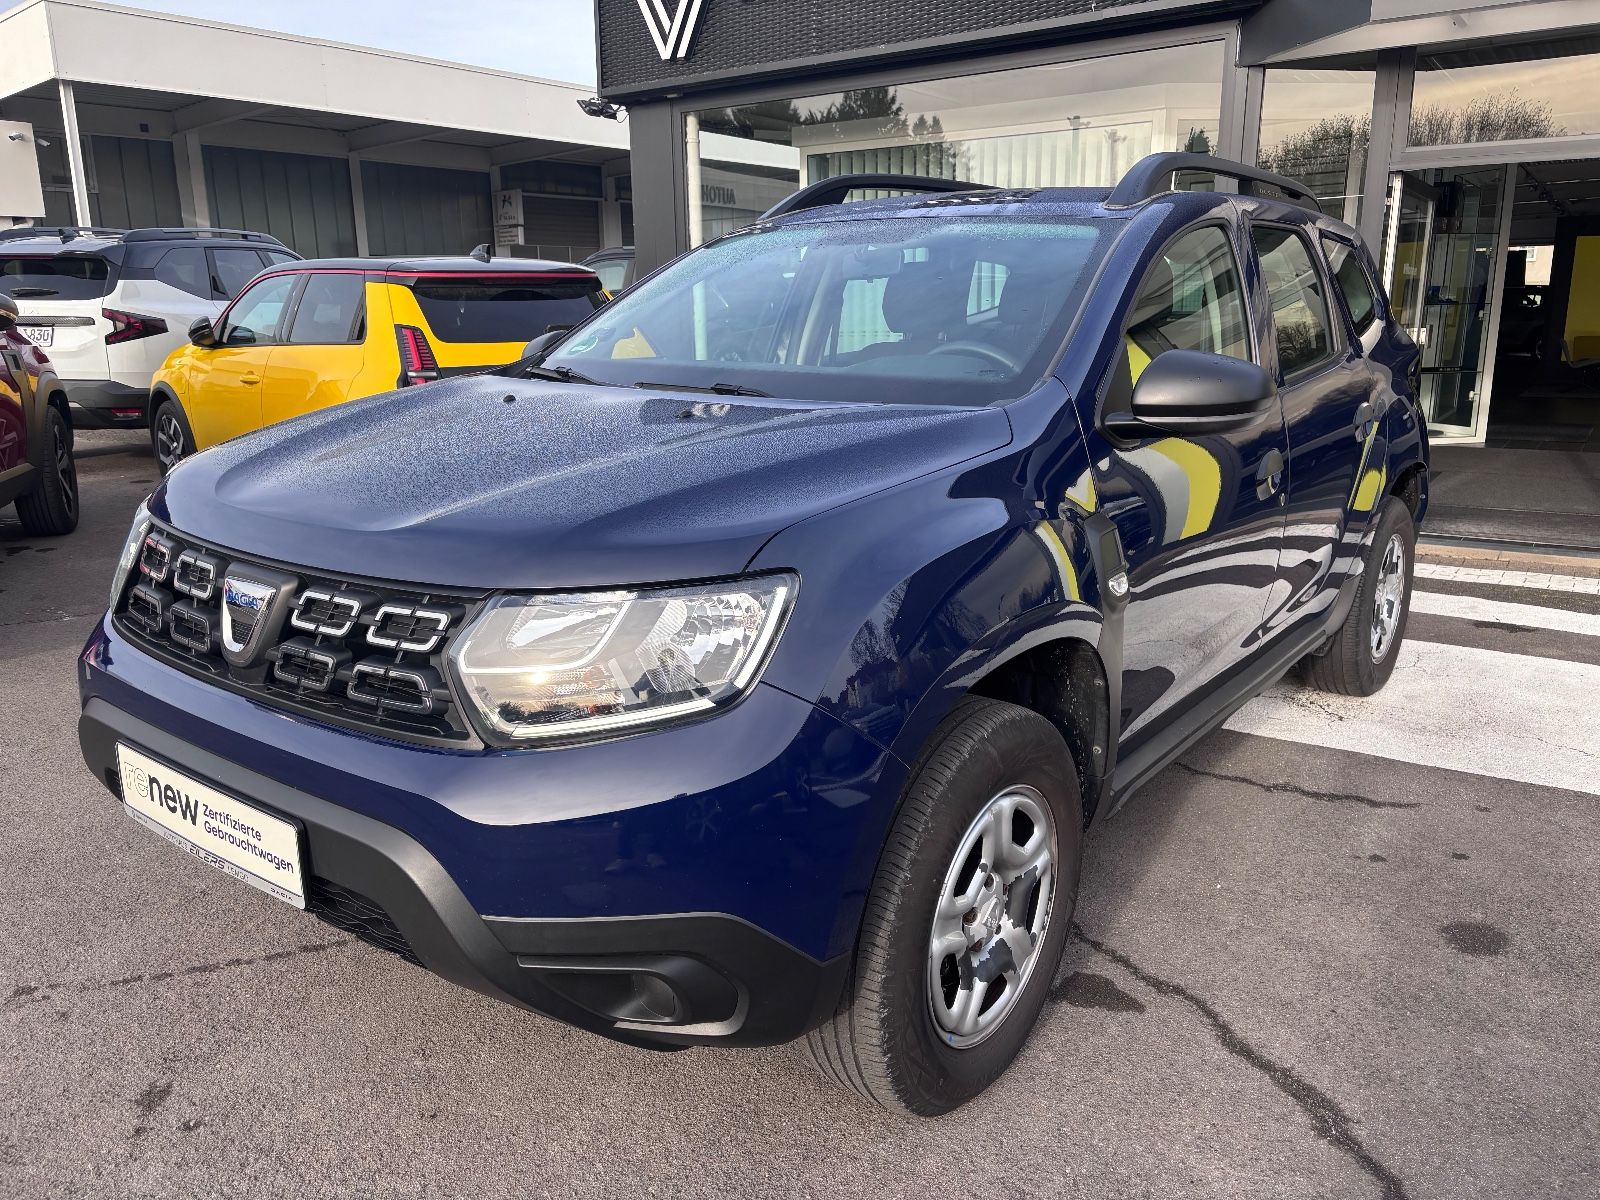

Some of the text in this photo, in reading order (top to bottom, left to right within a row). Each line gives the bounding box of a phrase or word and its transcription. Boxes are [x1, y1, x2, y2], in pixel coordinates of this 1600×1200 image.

[124, 762, 199, 827] renew
[202, 803, 262, 842] Zertifizierte
[189, 844, 226, 870] EILERS
[204, 820, 294, 874] Gebrauchtwagen
